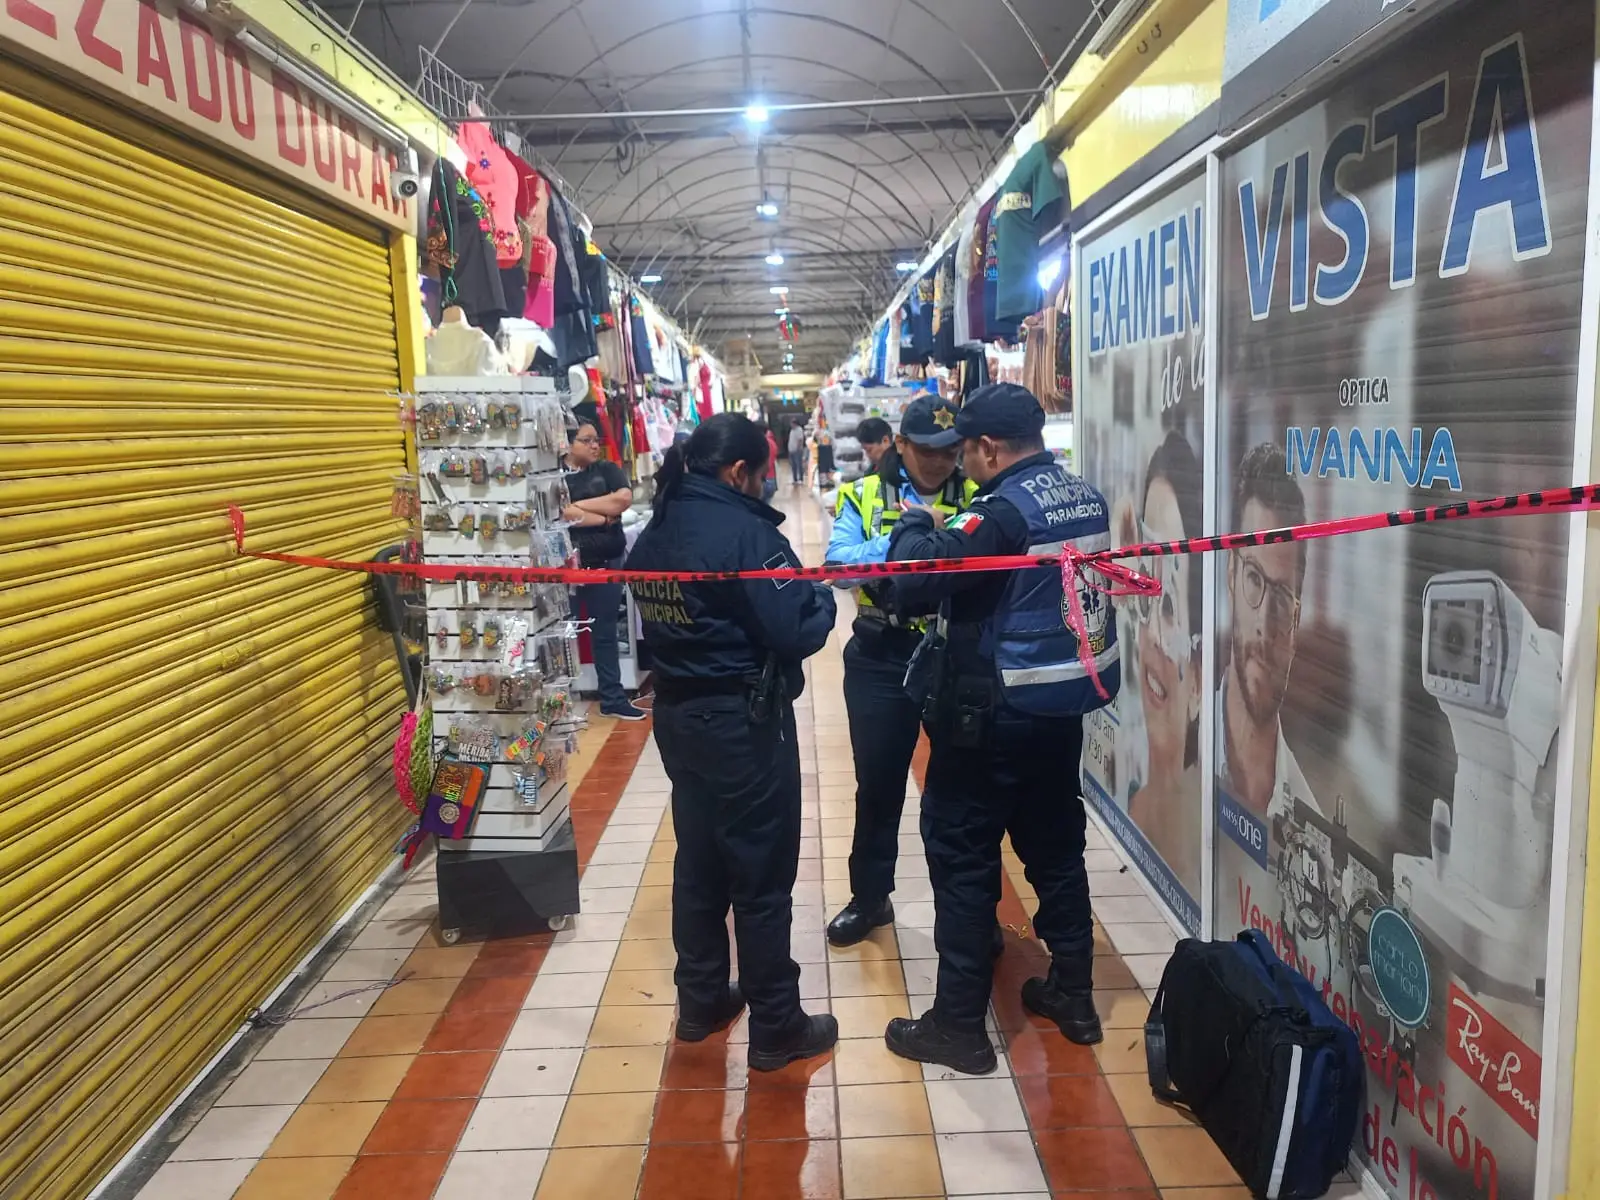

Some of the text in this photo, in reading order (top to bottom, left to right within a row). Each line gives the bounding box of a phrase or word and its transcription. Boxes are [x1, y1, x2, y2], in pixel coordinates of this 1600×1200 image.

[5, 0, 256, 141] ZADO
[1238, 32, 1552, 320] VISTA
[1088, 203, 1203, 355] EXAMEN
[1161, 344, 1185, 412] de
[1338, 377, 1390, 406] OPTICA
[1033, 483, 1098, 509] MUNICIPAL
[1286, 427, 1463, 492] IVANNA
[1045, 501, 1103, 526] PARAMÉDICO
[1238, 876, 1298, 970] Venta
[1453, 997, 1537, 1120] Ray-Ban
[1362, 1104, 1399, 1188] de
